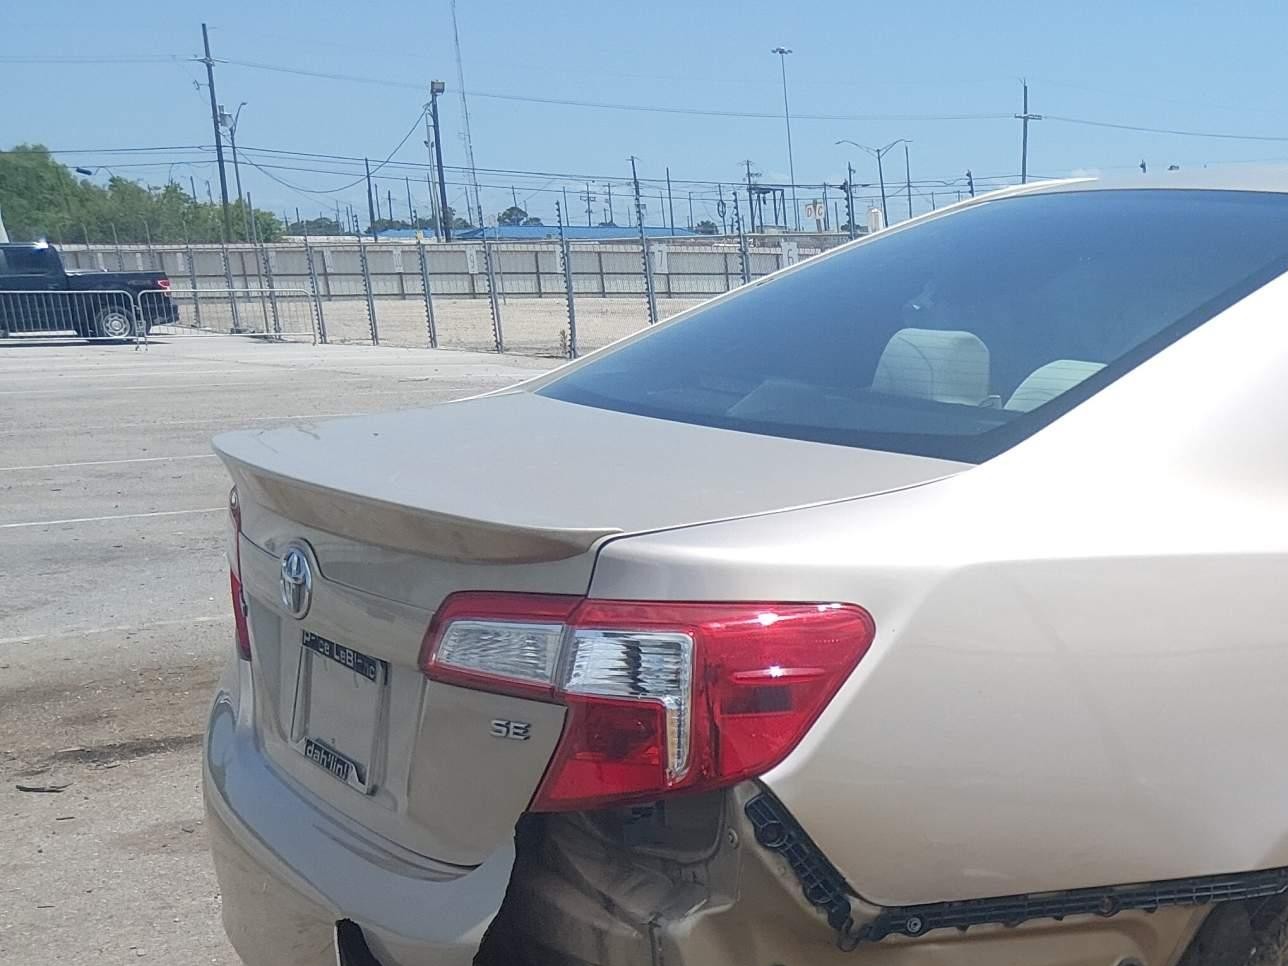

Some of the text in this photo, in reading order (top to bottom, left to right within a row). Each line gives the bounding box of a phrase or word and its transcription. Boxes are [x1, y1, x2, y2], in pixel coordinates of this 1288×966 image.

[303, 630, 377, 679] Pce LeBlc
[490, 720, 530, 740] SE
